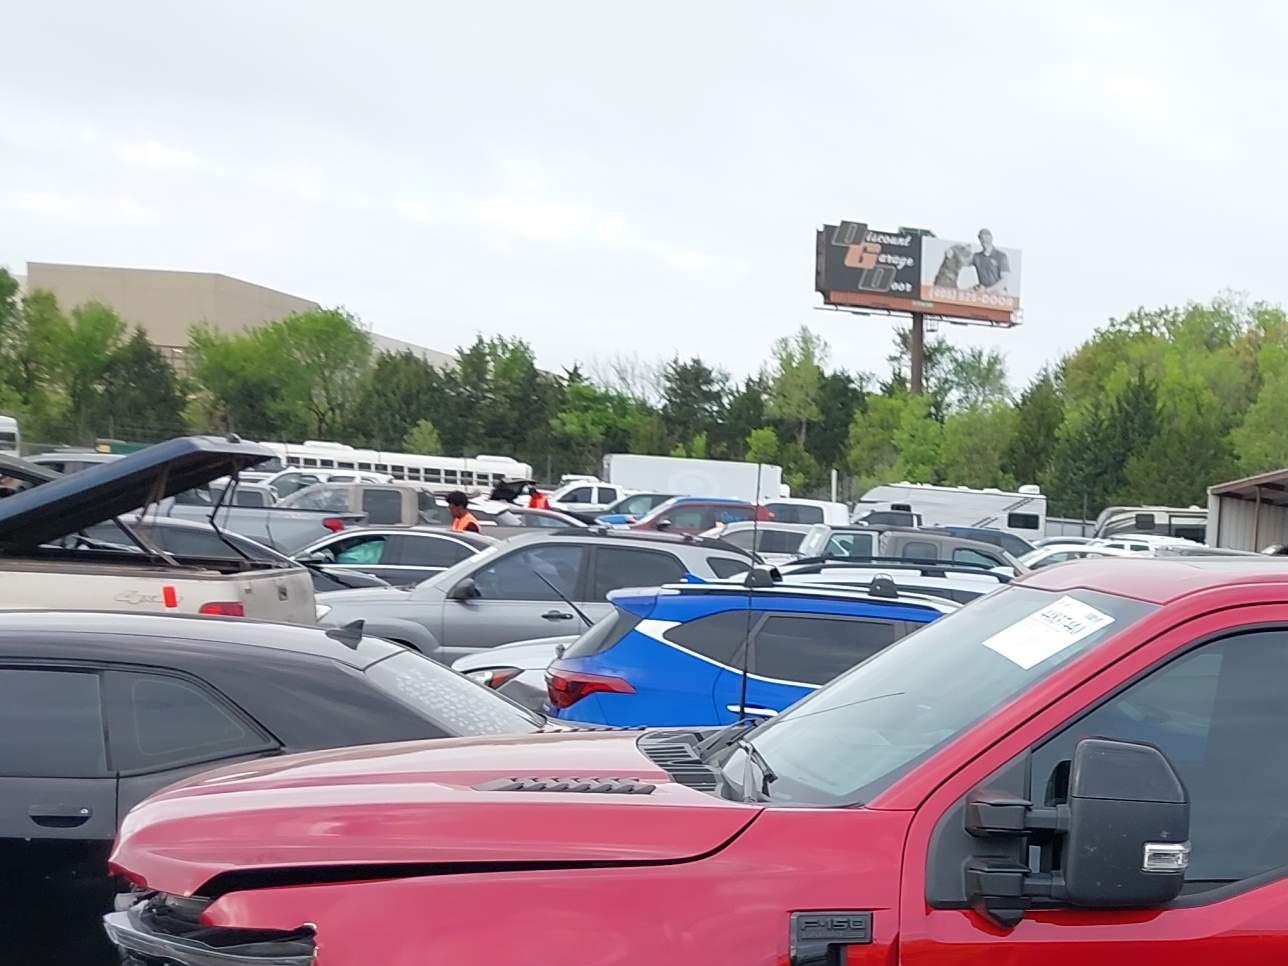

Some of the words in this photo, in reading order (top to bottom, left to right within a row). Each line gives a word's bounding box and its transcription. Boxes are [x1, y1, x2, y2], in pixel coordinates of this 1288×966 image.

[844, 242, 914, 270] Garage
[858, 264, 912, 292] Door
[800, 919, 866, 932] F-150
